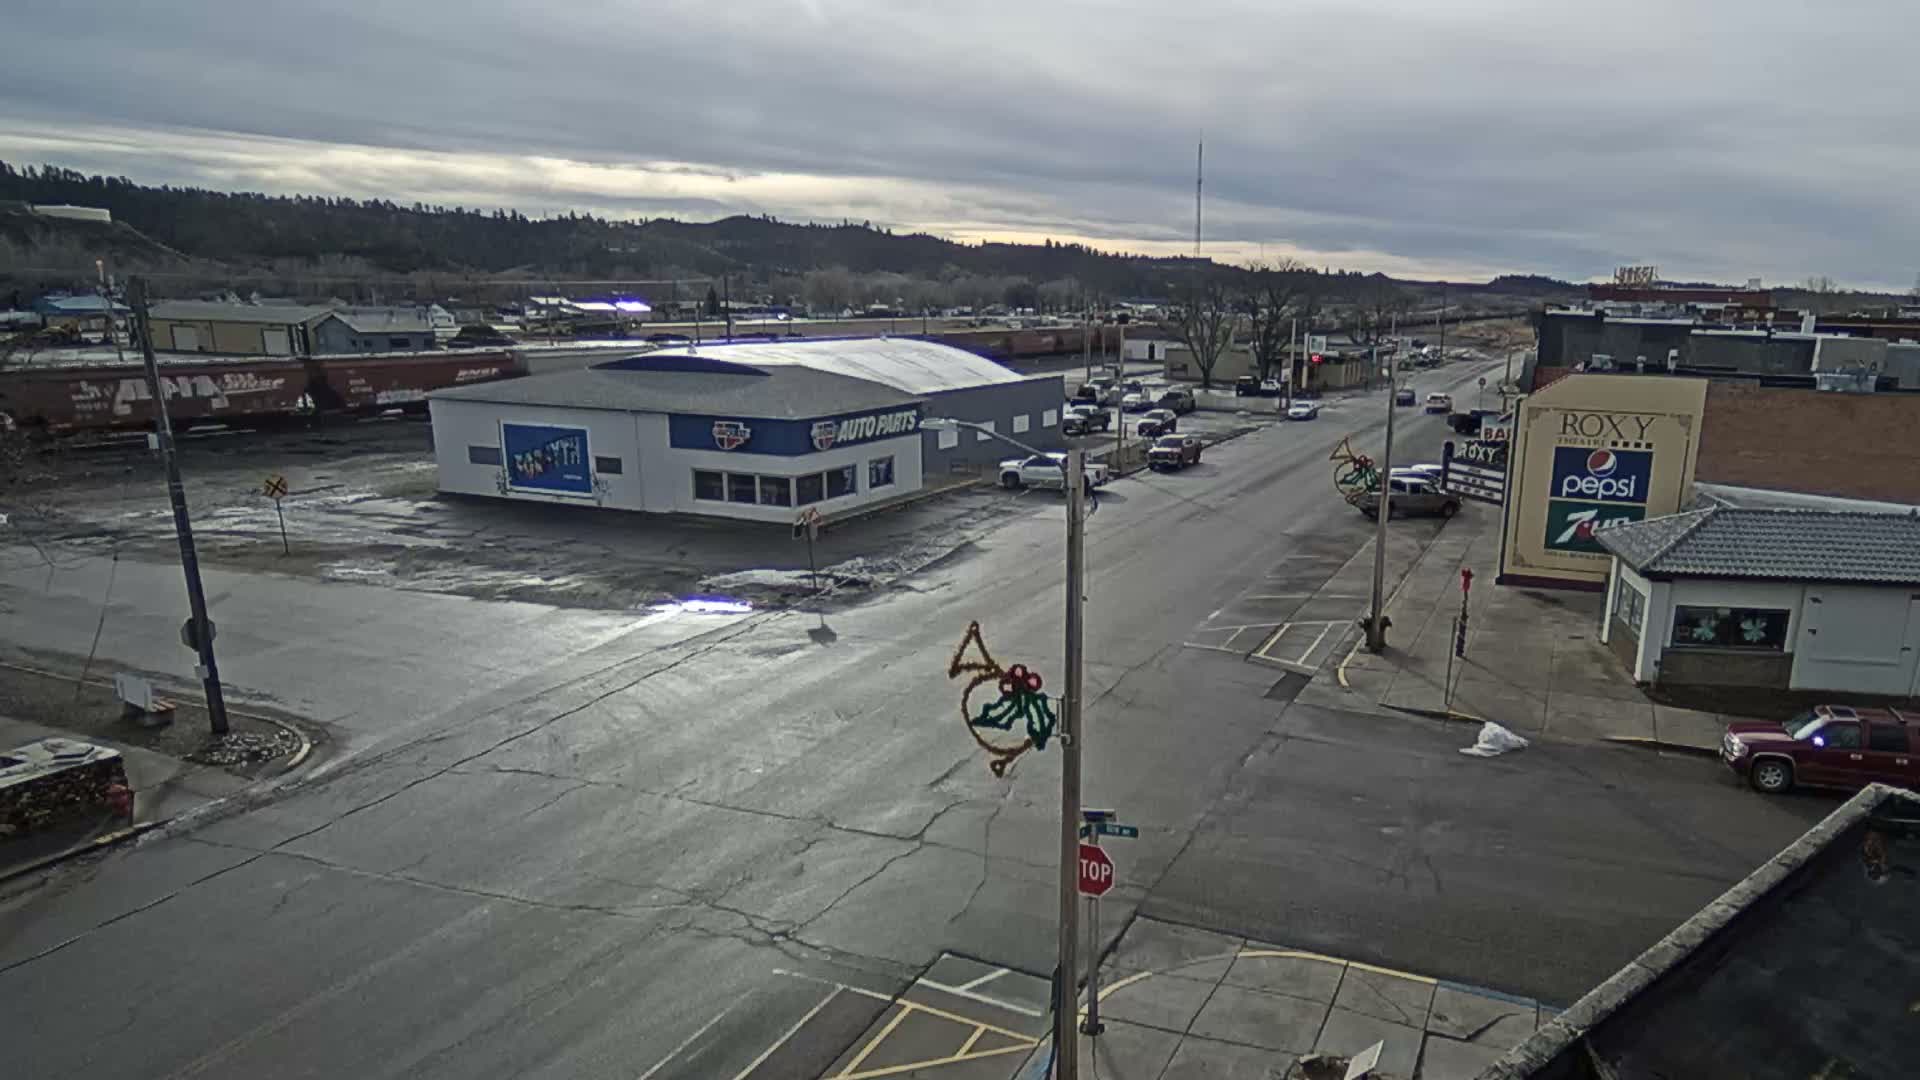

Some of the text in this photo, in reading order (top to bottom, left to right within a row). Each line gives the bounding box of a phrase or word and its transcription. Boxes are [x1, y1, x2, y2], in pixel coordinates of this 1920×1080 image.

[836, 415, 876, 443] AUTO
[876, 410, 918, 437] PARTS
[1559, 412, 1657, 440] ROXY
[1456, 442, 1499, 464] ROXY
[1562, 475, 1637, 500] pepsi
[1079, 859, 1111, 882] TOP
